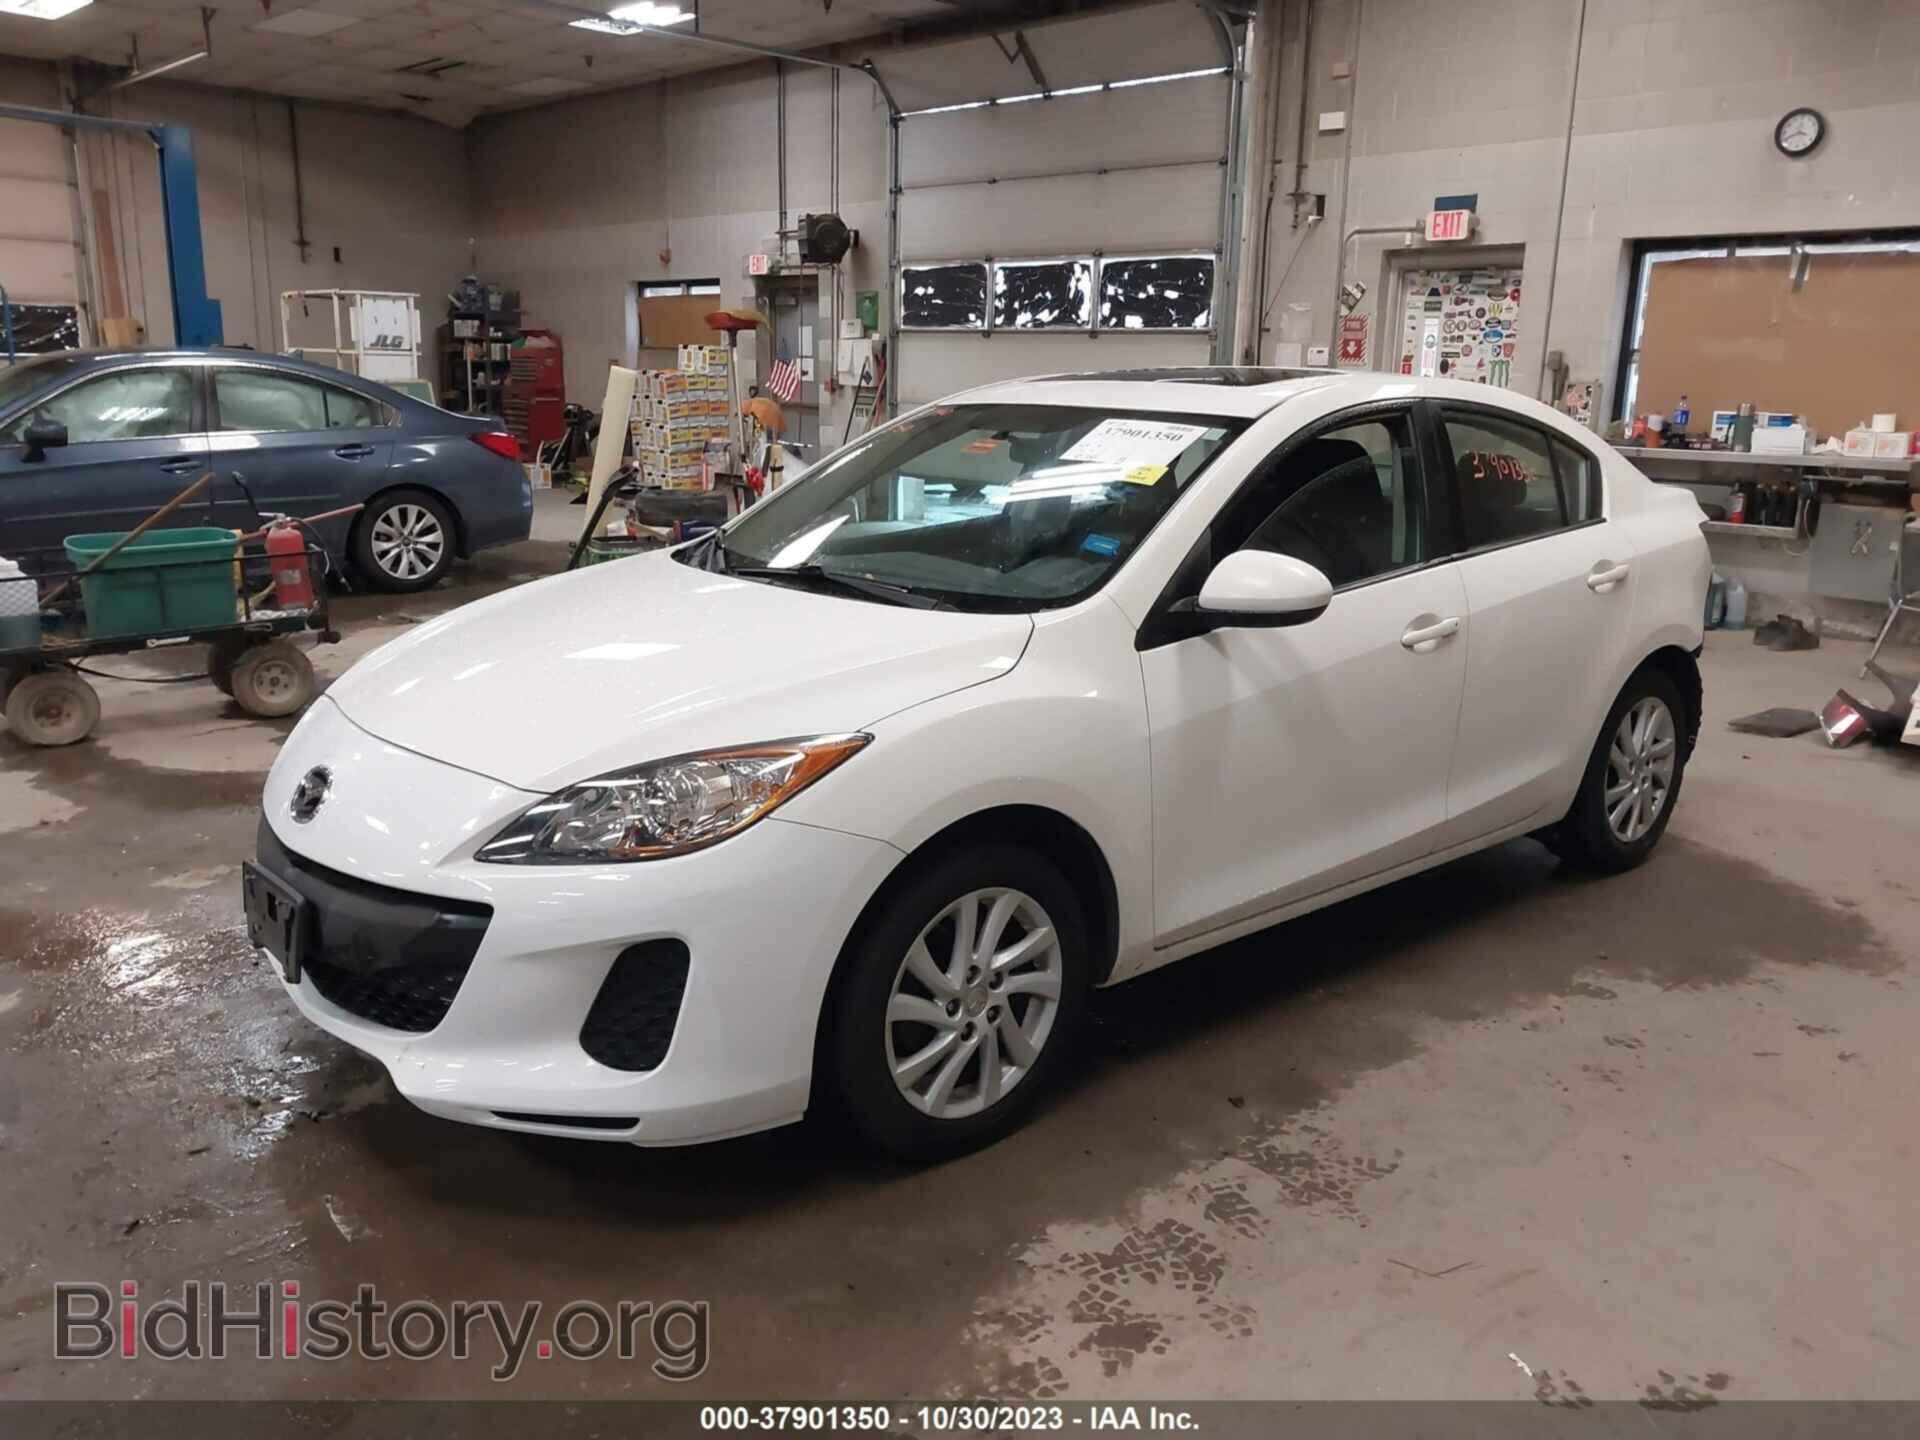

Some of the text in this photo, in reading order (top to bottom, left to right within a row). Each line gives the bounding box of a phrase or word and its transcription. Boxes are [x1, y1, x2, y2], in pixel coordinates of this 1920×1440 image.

[1432, 211, 1464, 238] EXIT
[752, 255, 766, 272] EXIT
[369, 334, 405, 349] JLG
